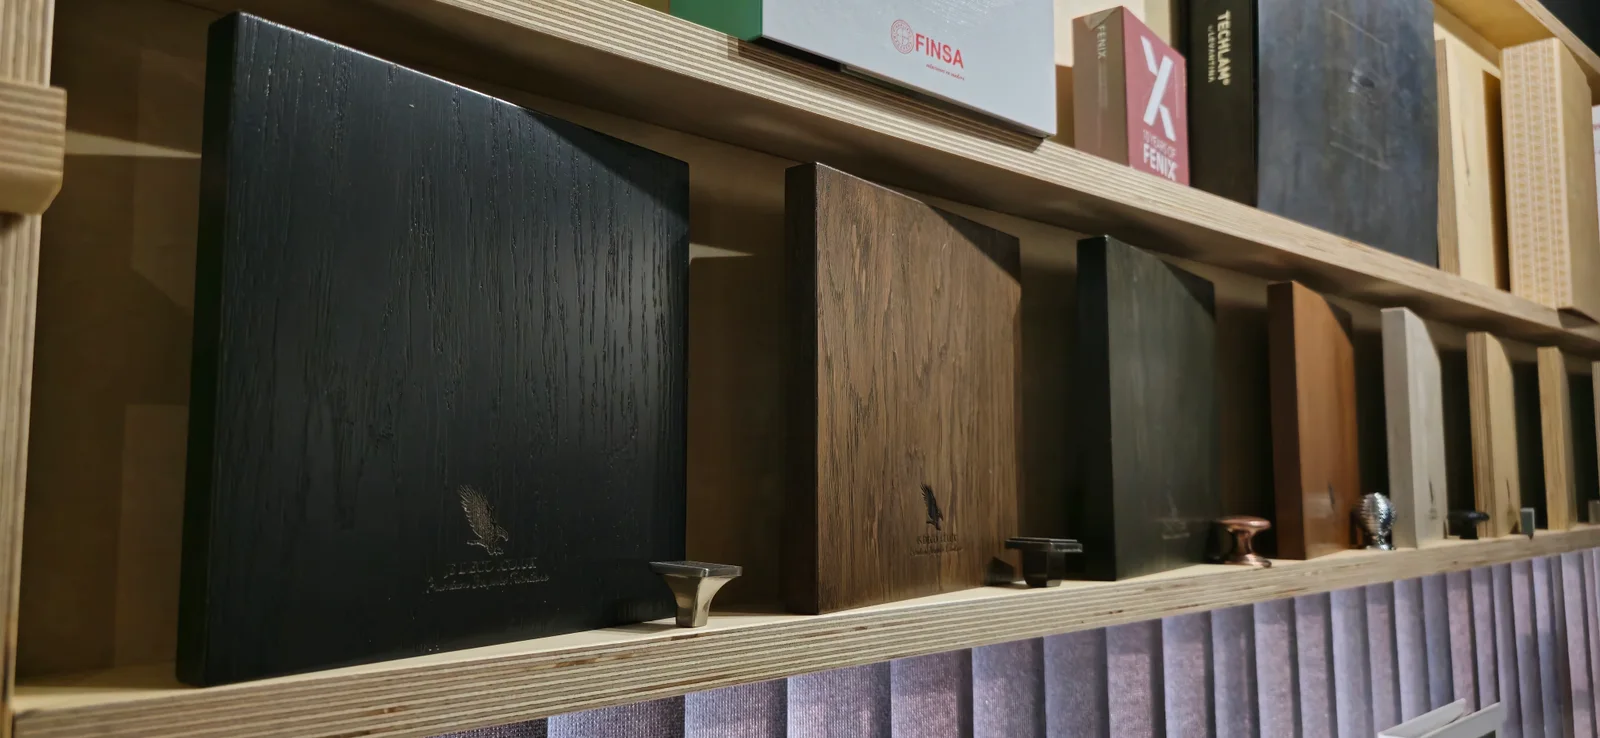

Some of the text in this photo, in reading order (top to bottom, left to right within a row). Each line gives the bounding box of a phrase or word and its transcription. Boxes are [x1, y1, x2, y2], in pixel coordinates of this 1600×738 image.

[915, 33, 964, 69] FINSA
[1096, 25, 1107, 59] FENIX
[1143, 143, 1177, 181] FENIX
